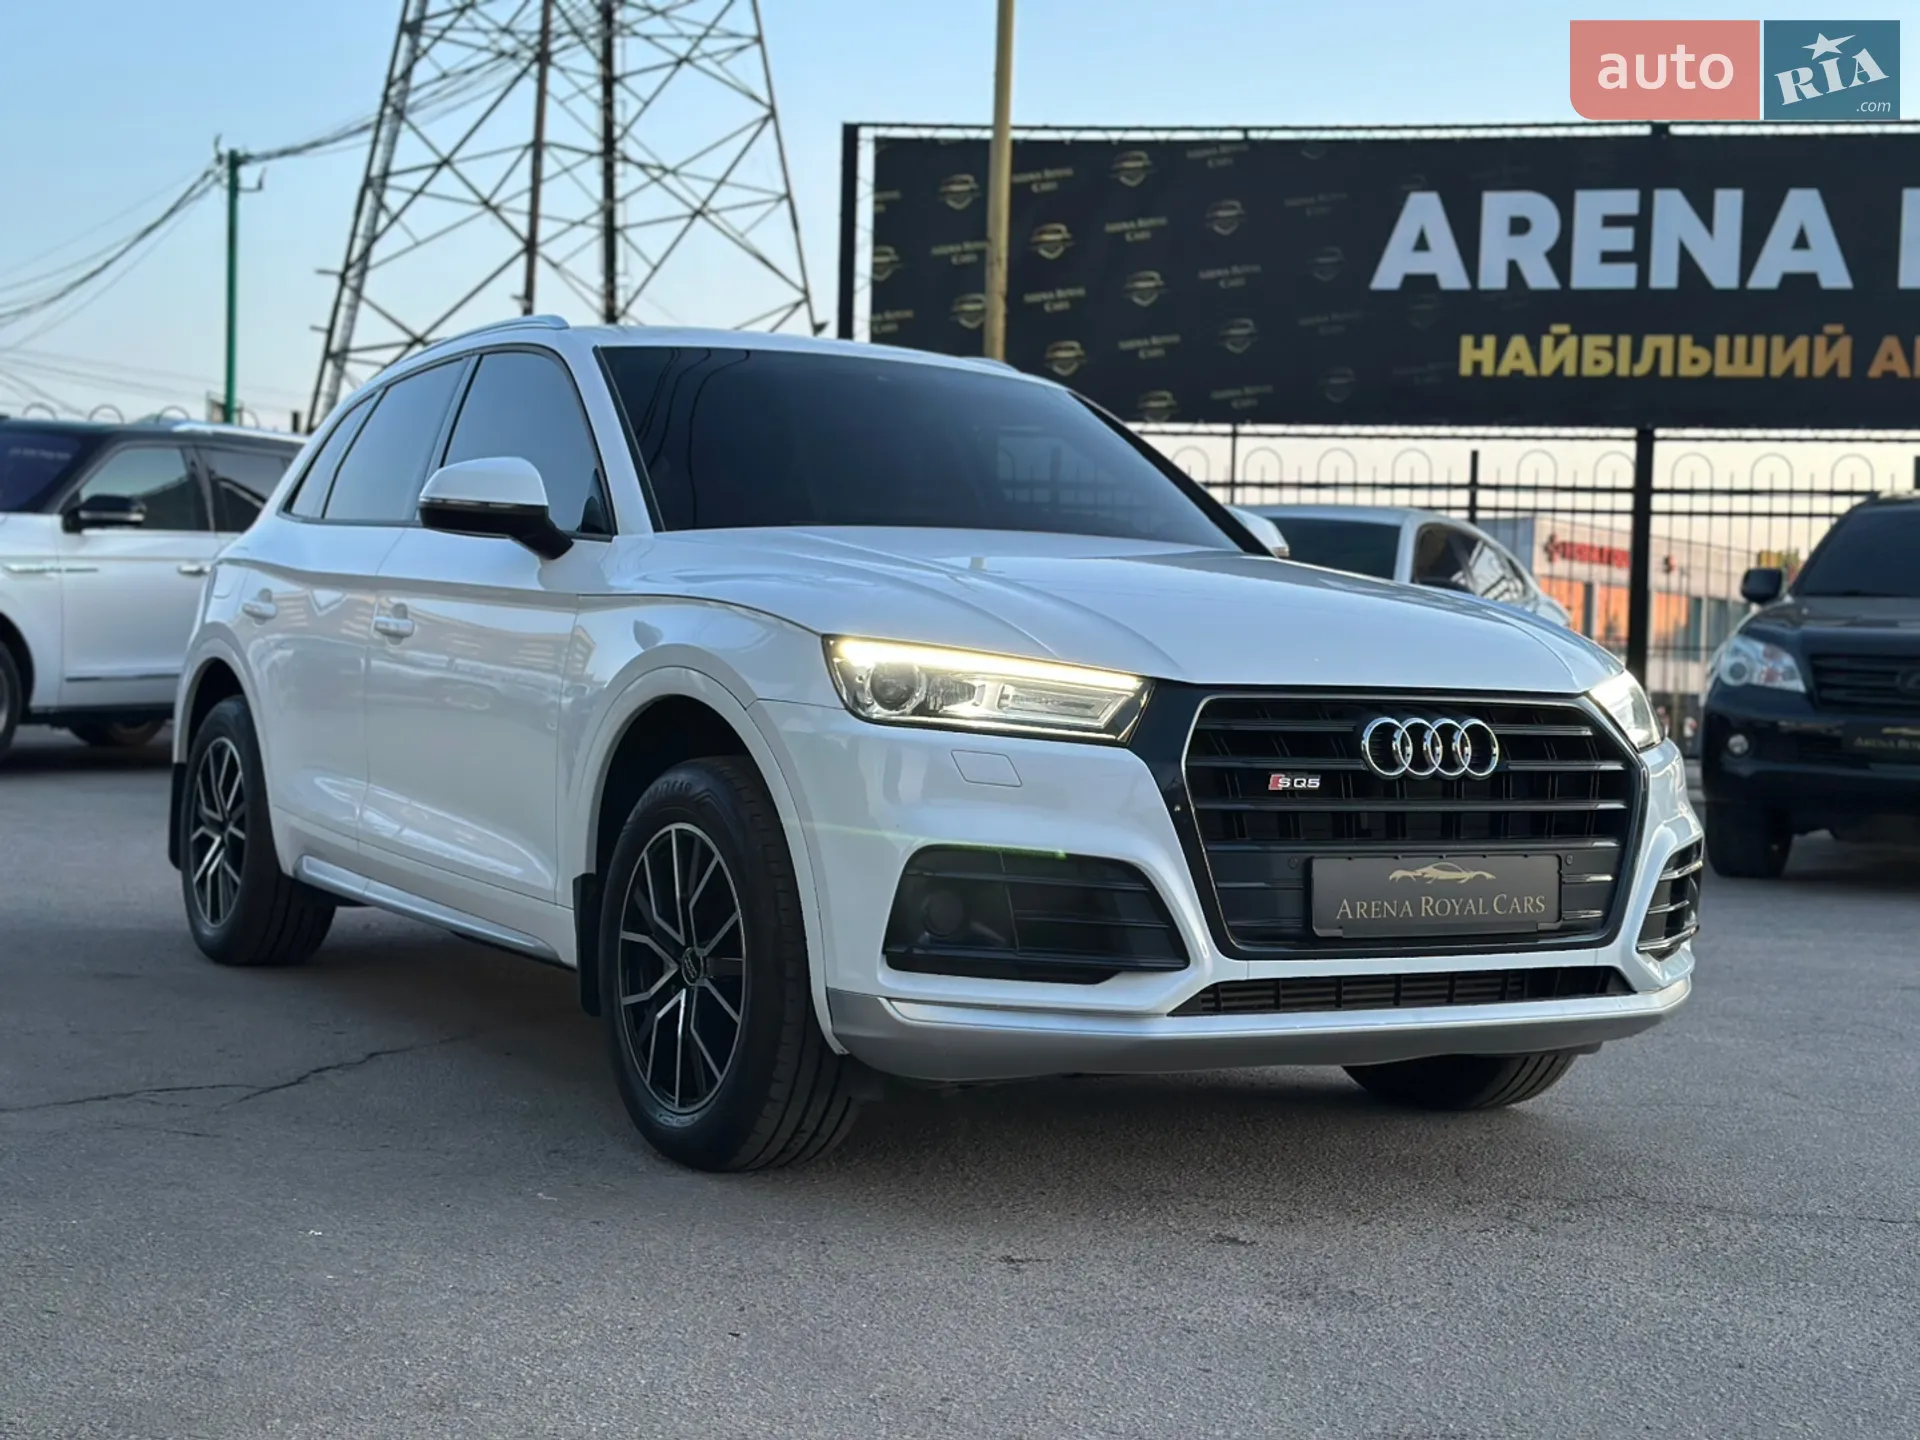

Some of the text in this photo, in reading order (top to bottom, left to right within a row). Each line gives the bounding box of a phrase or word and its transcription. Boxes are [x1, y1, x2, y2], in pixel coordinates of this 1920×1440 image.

[1368, 187, 1855, 290] ARENA
[1458, 324, 1854, 378] НАЙБІЛЬШИЙ
[1275, 776, 1320, 789] SQ5
[1336, 894, 1546, 920] ARENA ROYAL CARS
